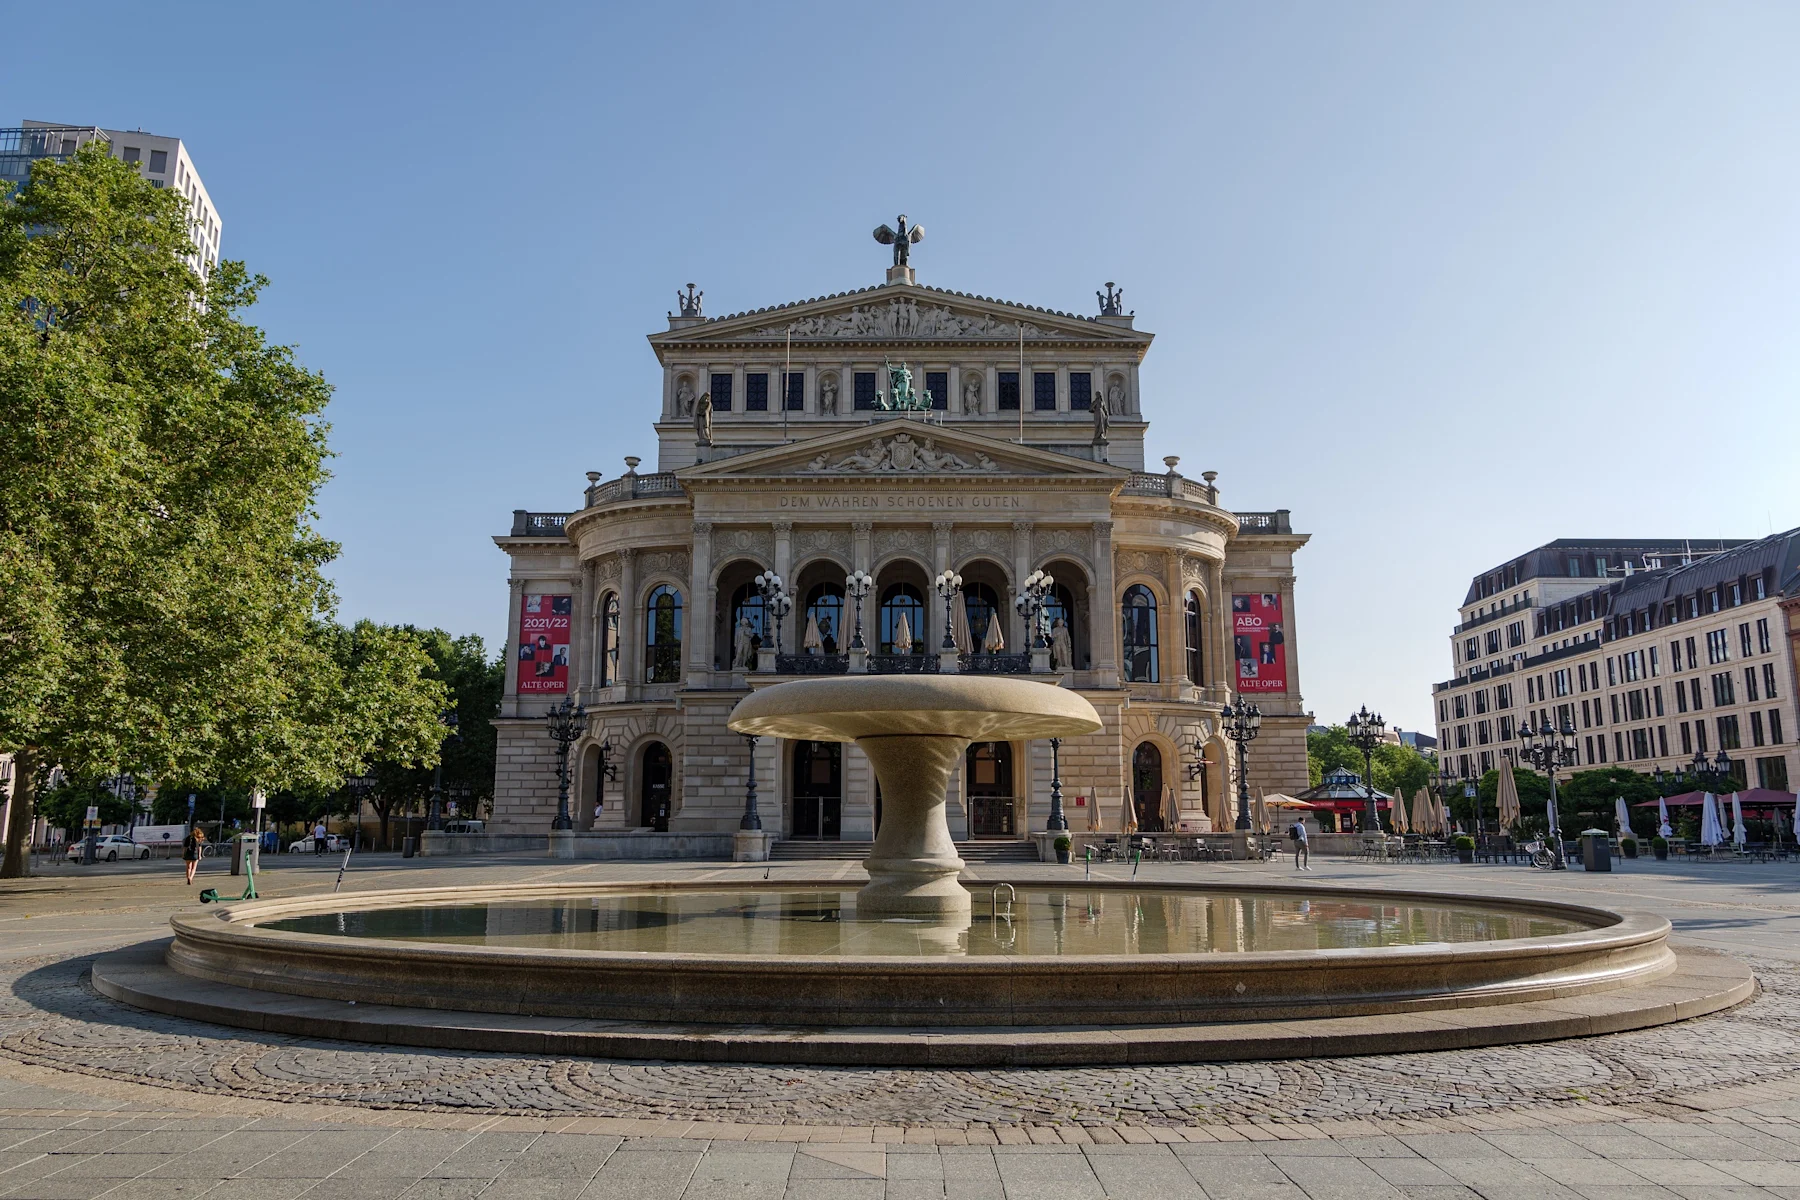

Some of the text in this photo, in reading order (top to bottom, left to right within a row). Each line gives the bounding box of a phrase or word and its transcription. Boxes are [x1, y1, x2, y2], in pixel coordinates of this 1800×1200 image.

[780, 496, 810, 507] DEM
[818, 496, 879, 507] WAHREN
[887, 496, 964, 507] SCHOENEN
[524, 617, 568, 629] 2021/22
[1236, 617, 1262, 627] ABO
[521, 681, 565, 689] ALTE OPER
